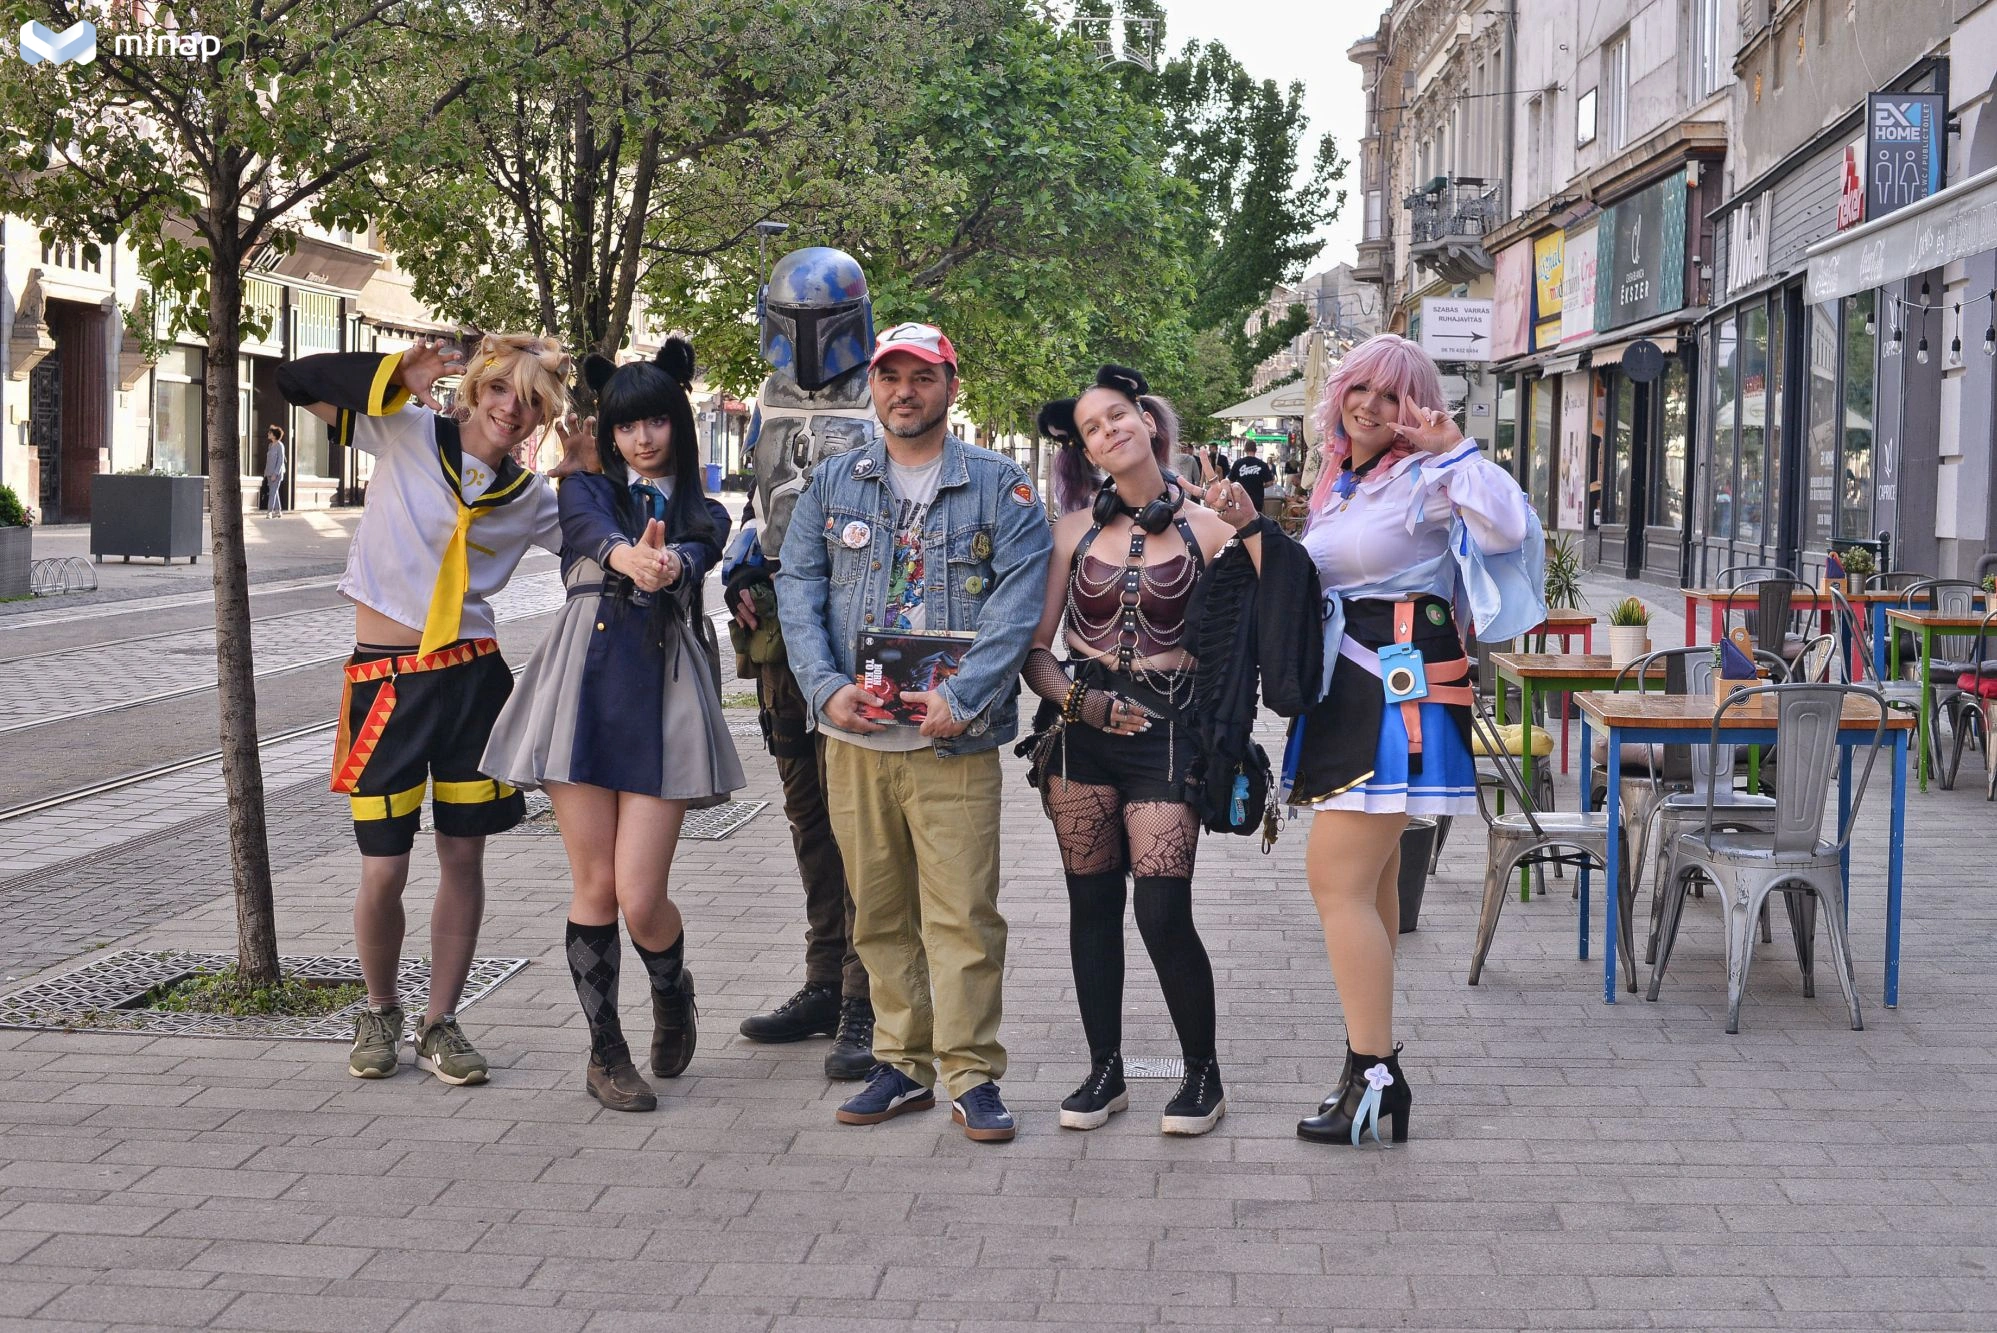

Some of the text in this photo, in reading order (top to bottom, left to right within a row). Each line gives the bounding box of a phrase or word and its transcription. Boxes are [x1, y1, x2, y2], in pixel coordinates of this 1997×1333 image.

[1875, 102, 1922, 126] EX
[1875, 126, 1921, 140] HOME
[1922, 173, 1929, 186] WC
[1936, 230, 1945, 255] és
[1620, 280, 1649, 306] ÉKSZER
[1879, 484, 1896, 501] CAPRICE
[864, 659, 875, 690] TO KILL
[874, 663, 883, 686] BORN
